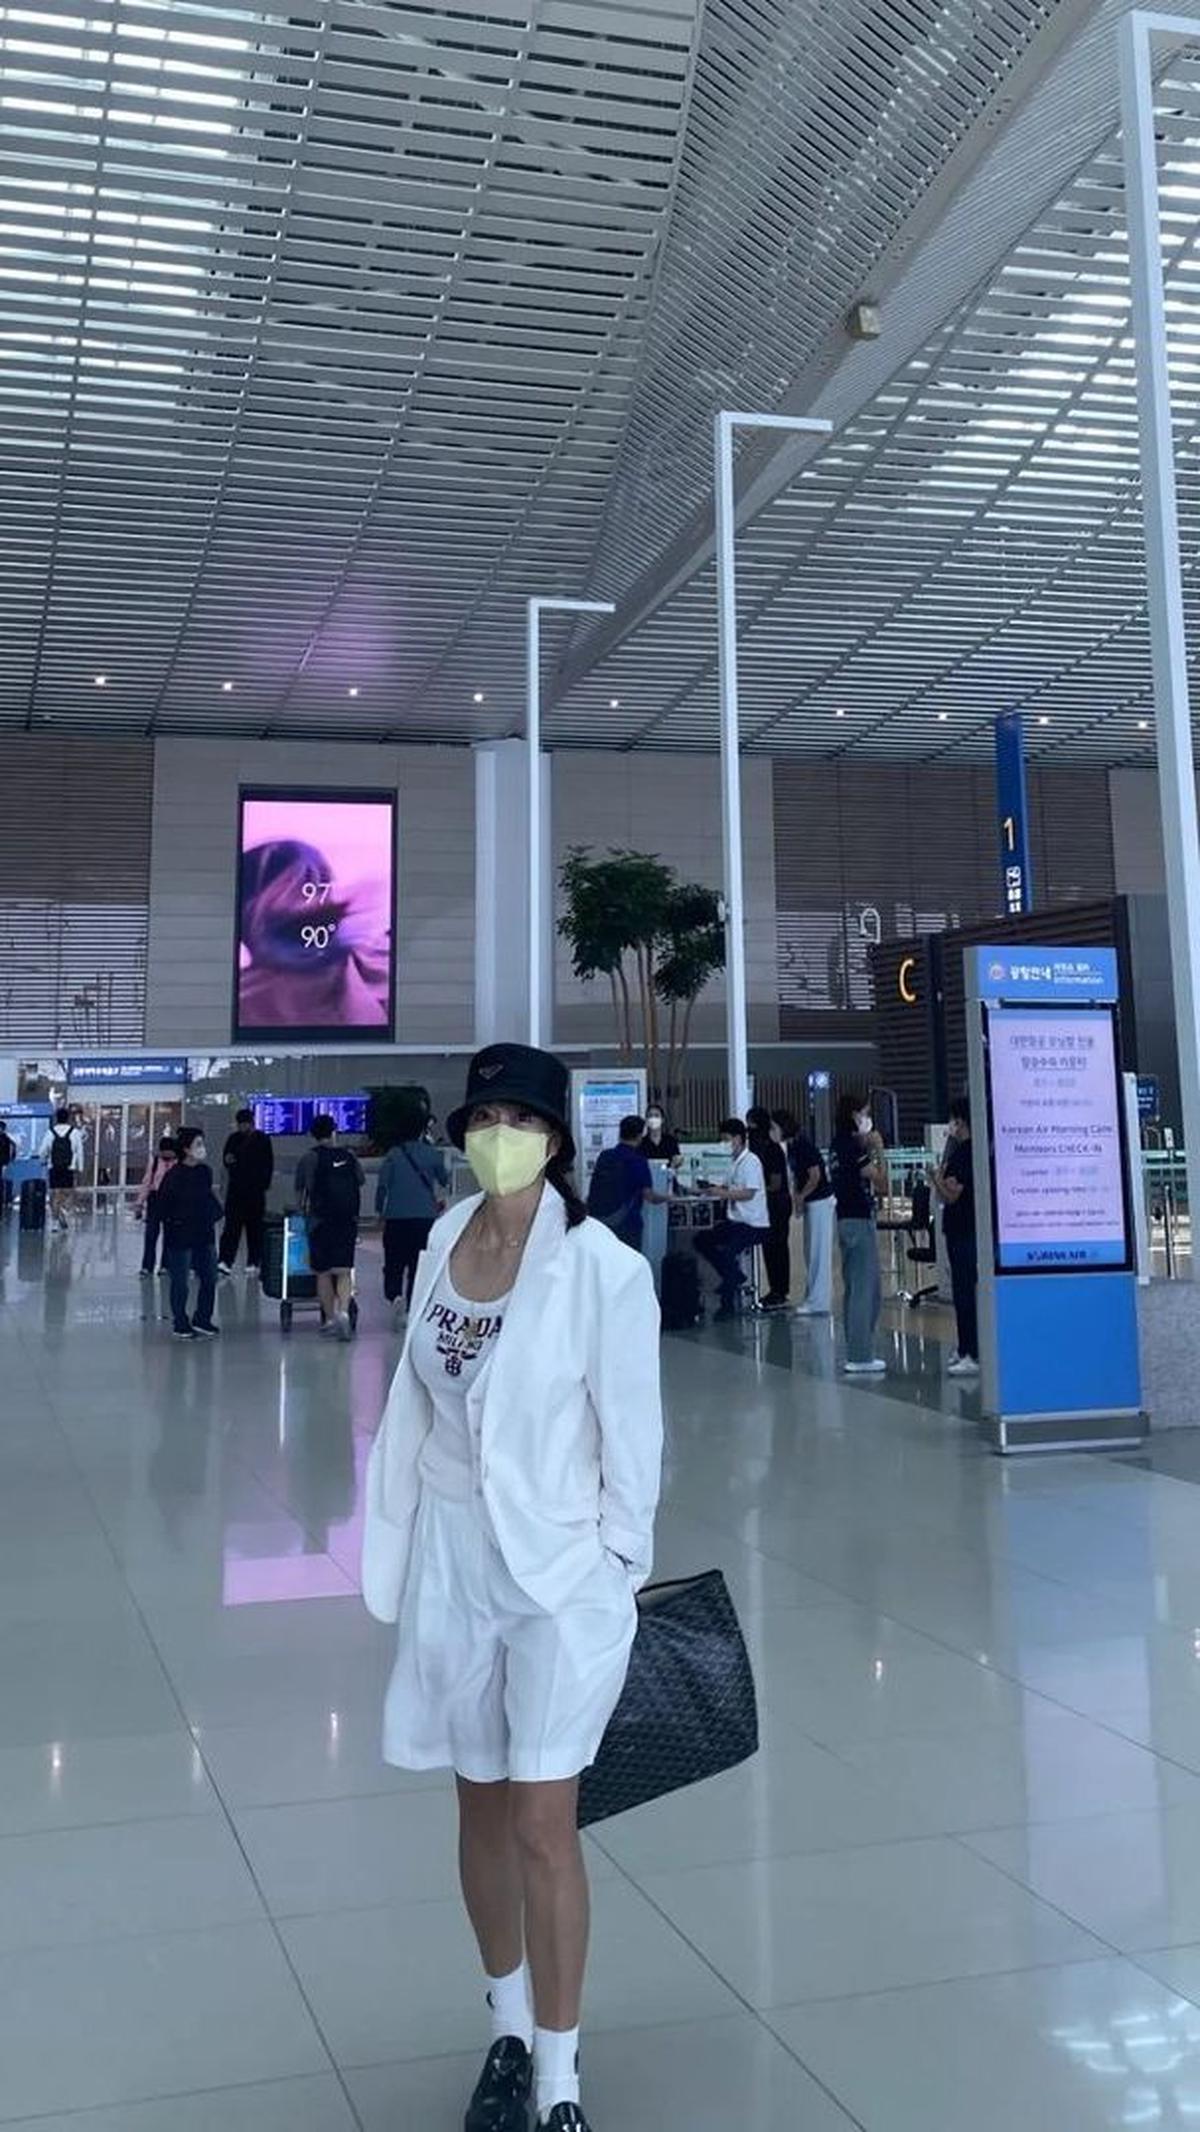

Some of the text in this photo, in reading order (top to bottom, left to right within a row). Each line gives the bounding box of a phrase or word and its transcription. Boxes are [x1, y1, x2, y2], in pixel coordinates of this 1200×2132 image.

[1003, 817, 1014, 851] 1
[302, 882, 330, 903] 97
[900, 958, 915, 1001] C
[1001, 1125, 1034, 1134] Korean
[1051, 1125, 1088, 1137] Morning
[427, 1303, 503, 1338] PRADA
